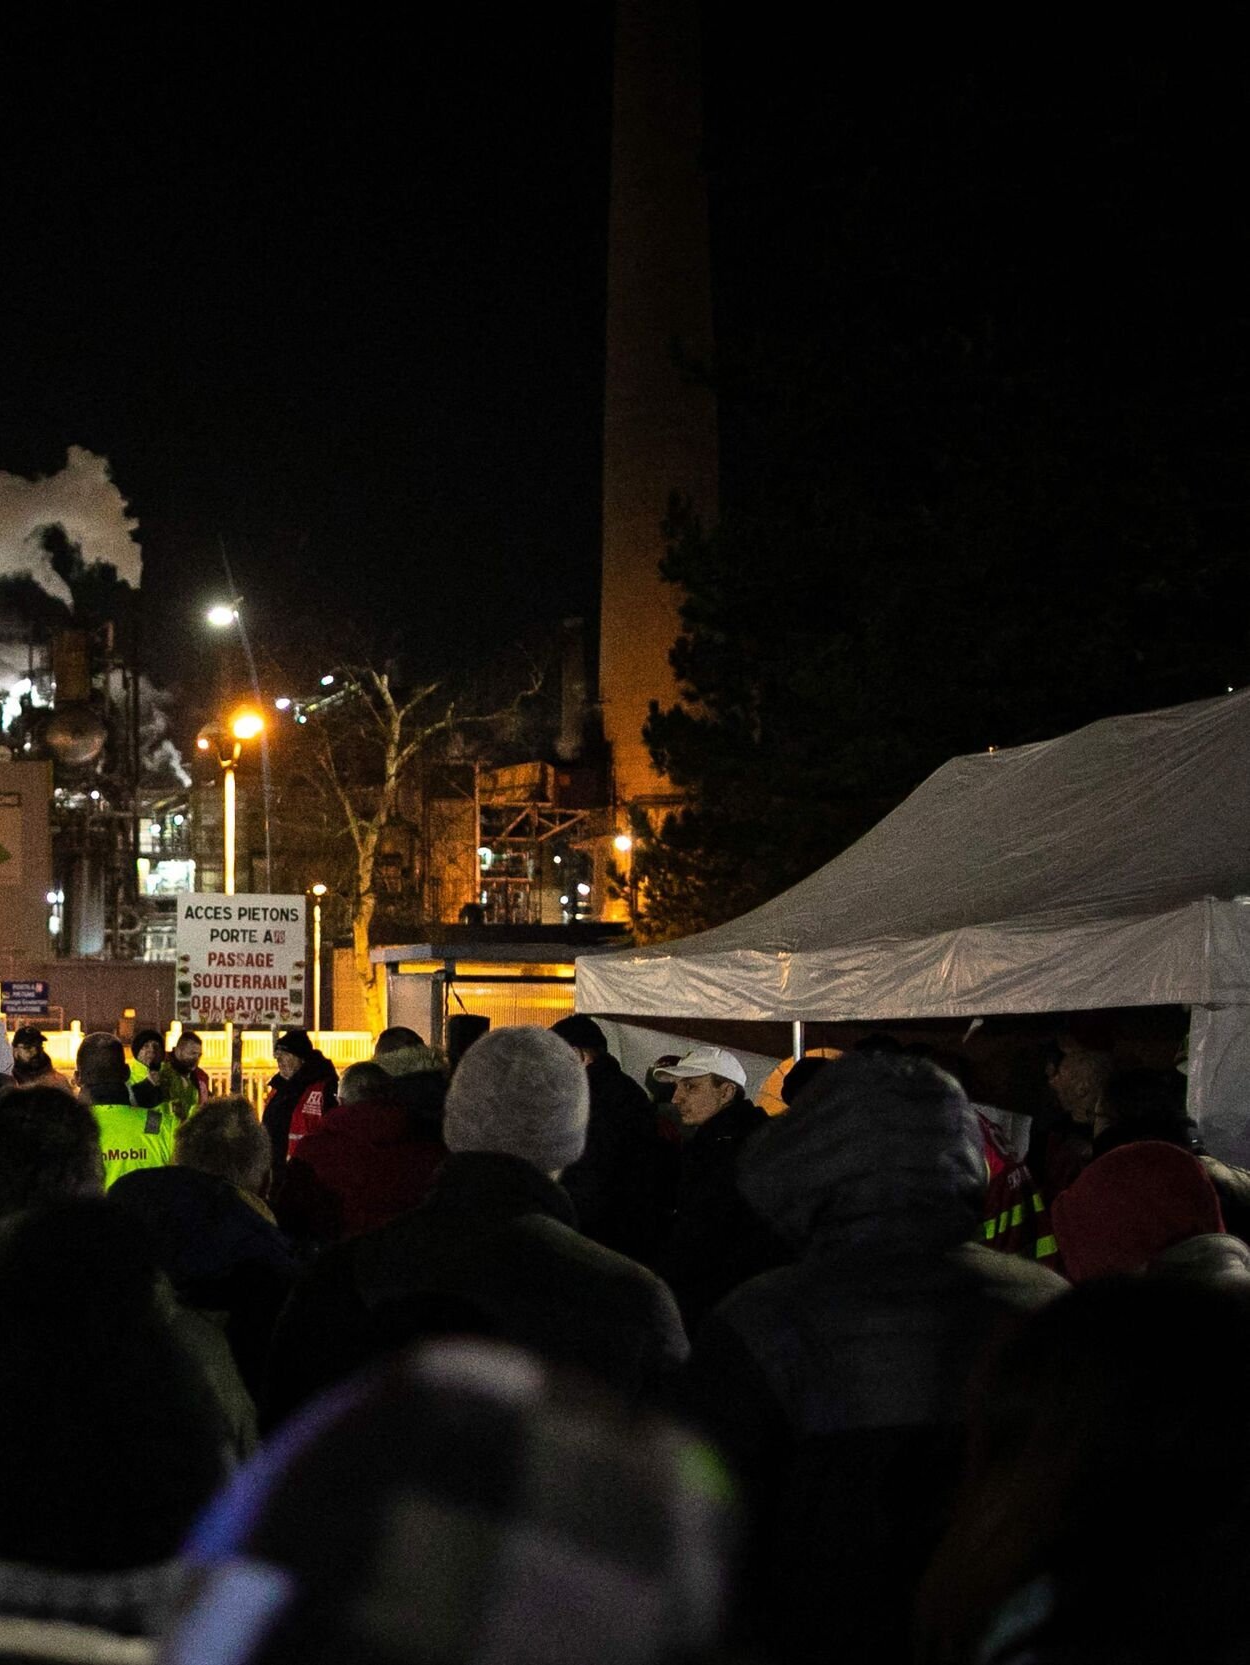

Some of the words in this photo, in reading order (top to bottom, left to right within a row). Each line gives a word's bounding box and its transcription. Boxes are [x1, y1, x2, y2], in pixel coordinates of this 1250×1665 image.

[185, 906, 232, 920] ACCES
[238, 907, 299, 922] PIETONS
[210, 928, 258, 943] PORTE
[263, 929, 273, 943] A
[207, 952, 274, 968] PASSAGE
[193, 973, 287, 990] SOUTERRAIN
[191, 995, 289, 1012] OBLIGATOIRE
